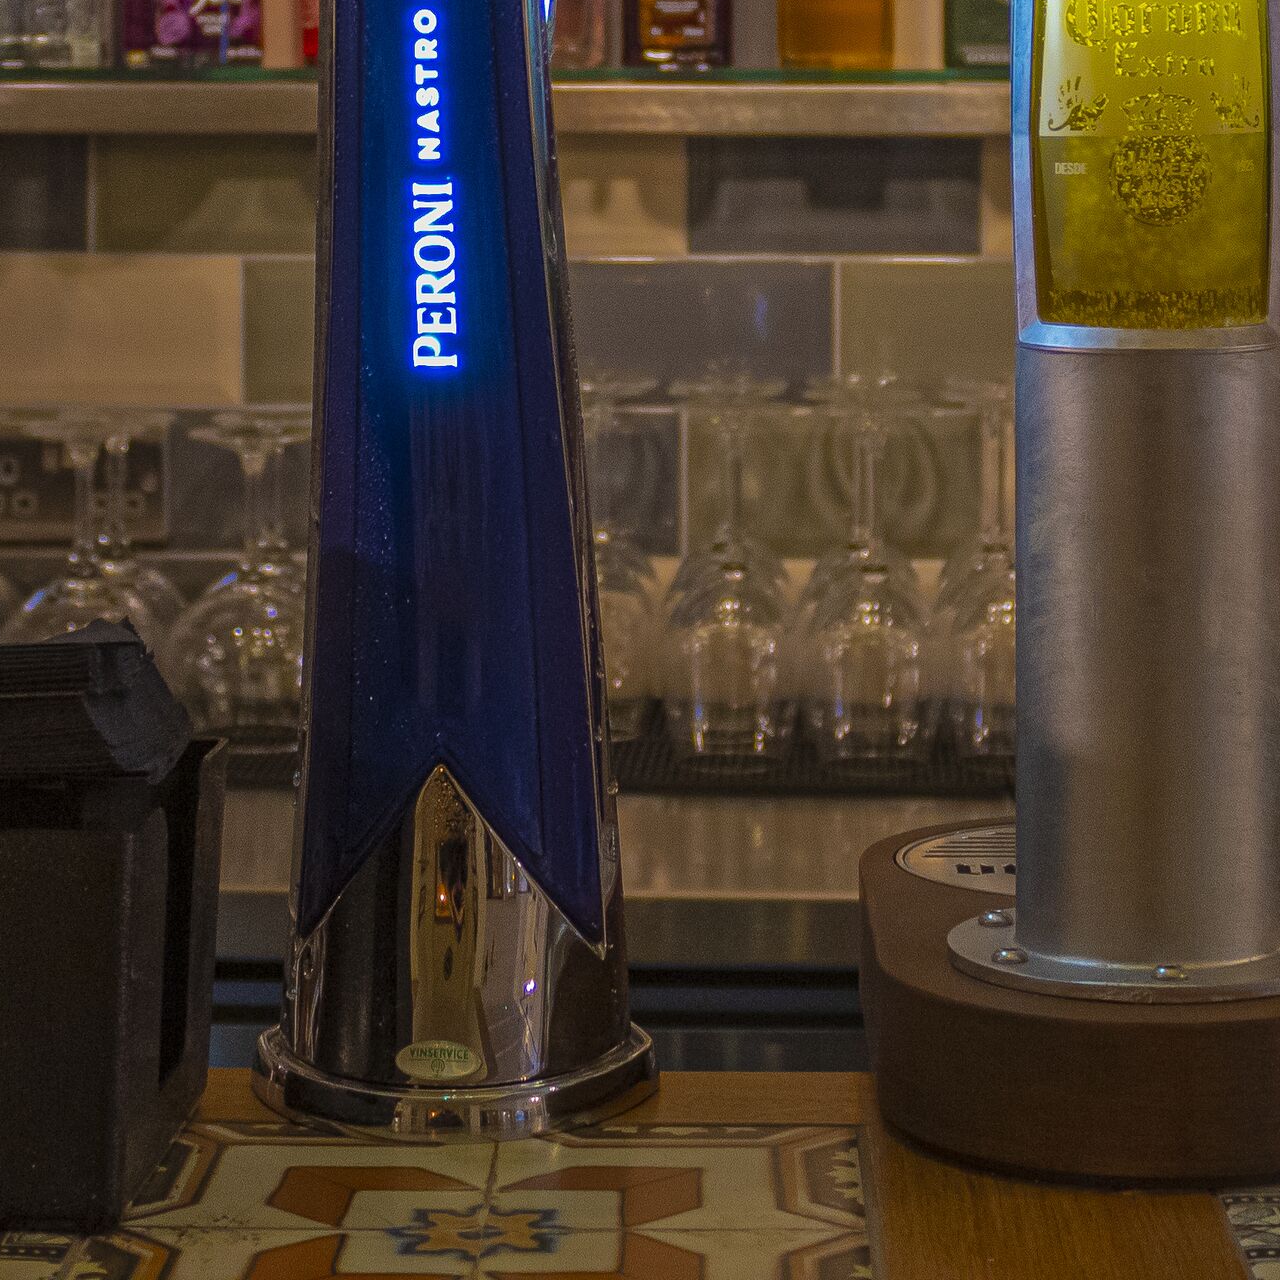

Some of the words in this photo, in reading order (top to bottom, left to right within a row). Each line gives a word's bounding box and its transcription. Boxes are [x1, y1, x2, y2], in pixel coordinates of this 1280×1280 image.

[413, 9, 441, 160] NASTRO
[1114, 41, 1216, 79] Extra
[412, 181, 458, 368] PERONI
[409, 1046, 469, 1060] VINSERVICE
